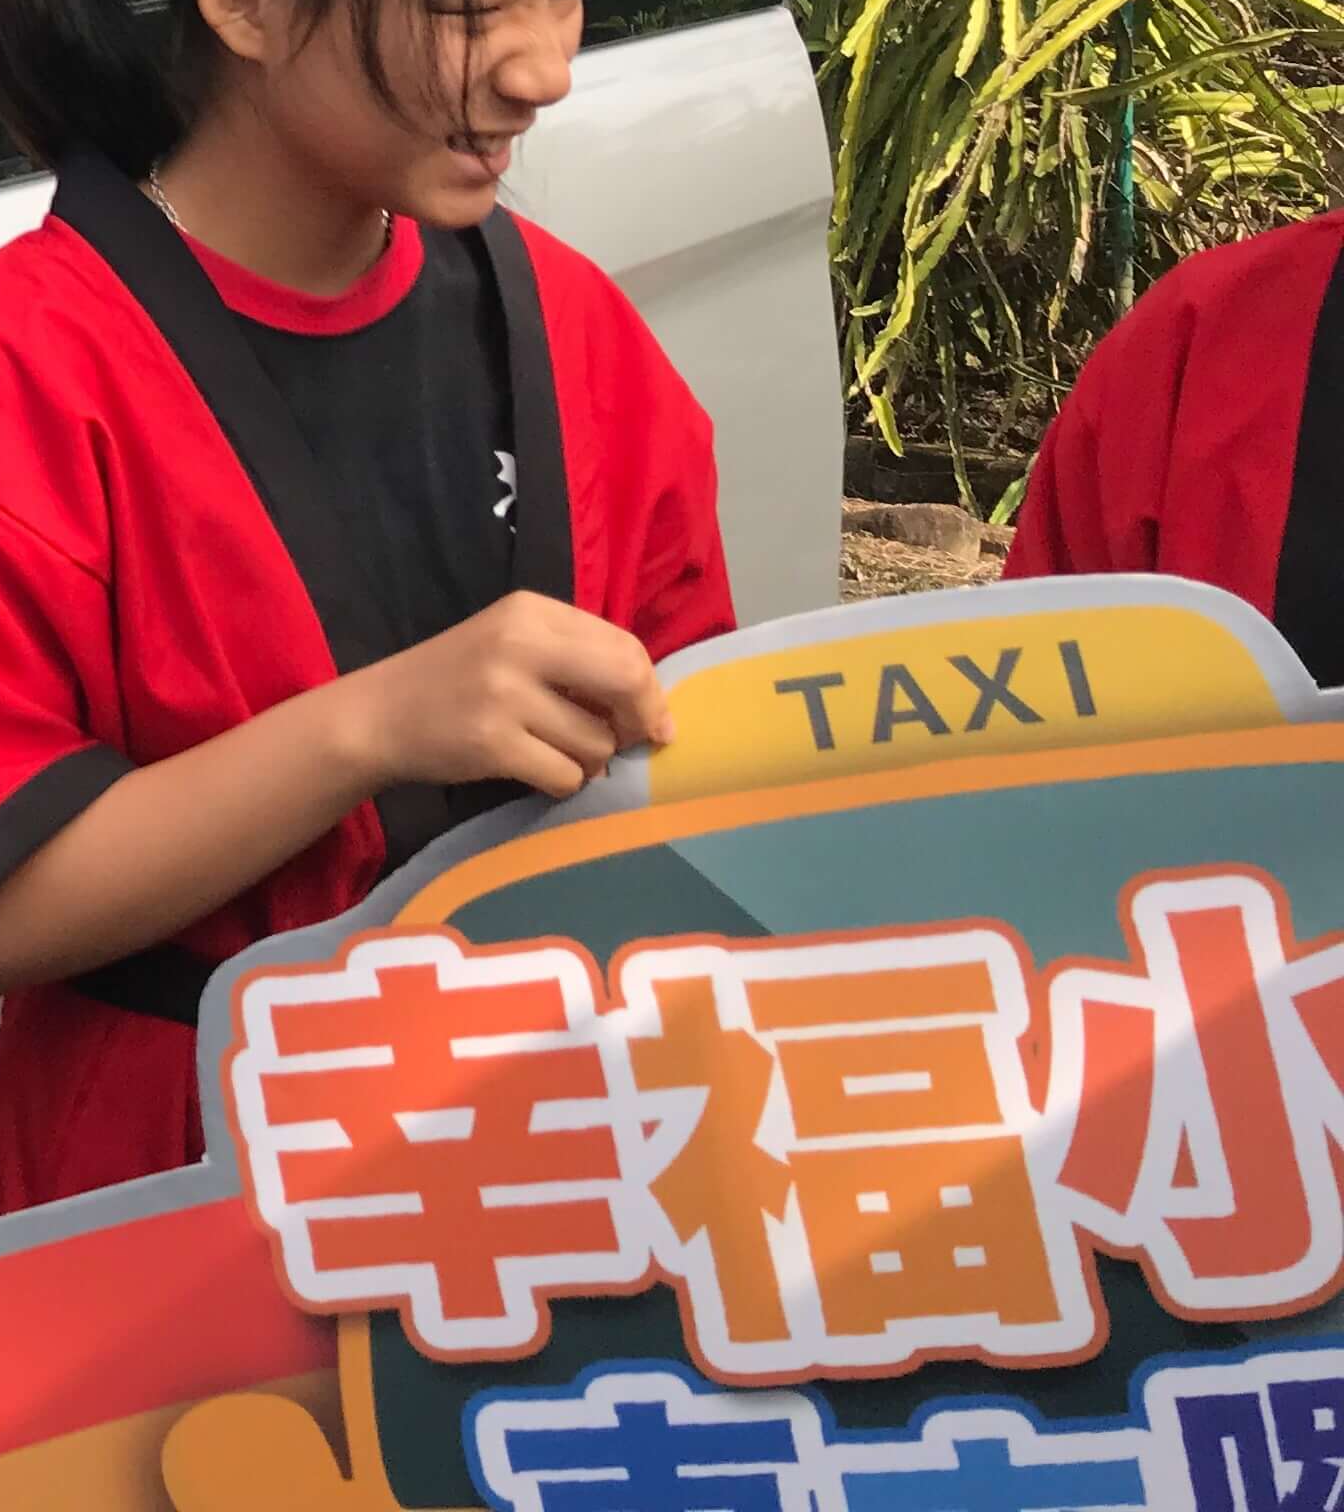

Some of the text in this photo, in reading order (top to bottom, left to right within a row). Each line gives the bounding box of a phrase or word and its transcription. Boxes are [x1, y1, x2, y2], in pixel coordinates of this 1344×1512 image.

[773, 639, 1098, 752] TAXI
[256, 903, 1344, 1345] 幸福小
